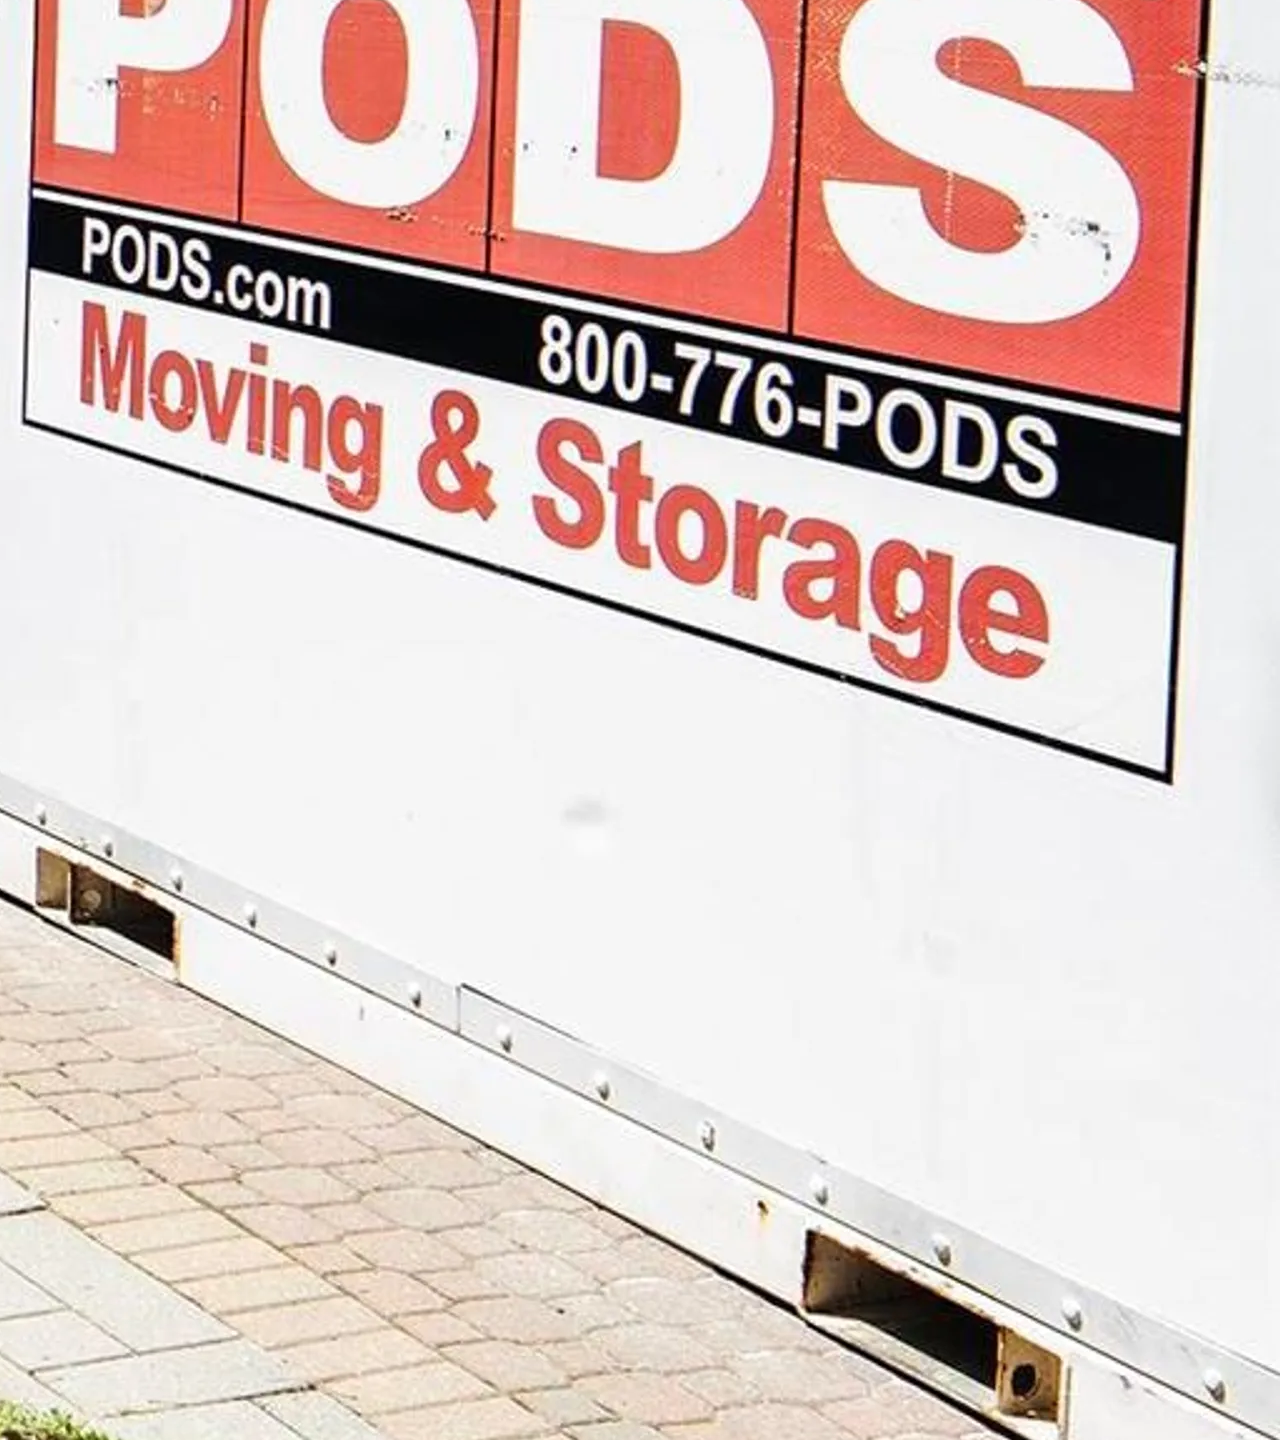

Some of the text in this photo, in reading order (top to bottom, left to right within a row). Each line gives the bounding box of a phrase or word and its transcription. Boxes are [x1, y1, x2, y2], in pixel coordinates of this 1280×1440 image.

[82, 217, 332, 330] PODS.com
[80, 300, 1051, 683] Moving & Storage
[539, 315, 1059, 499] 800-776-PODS
